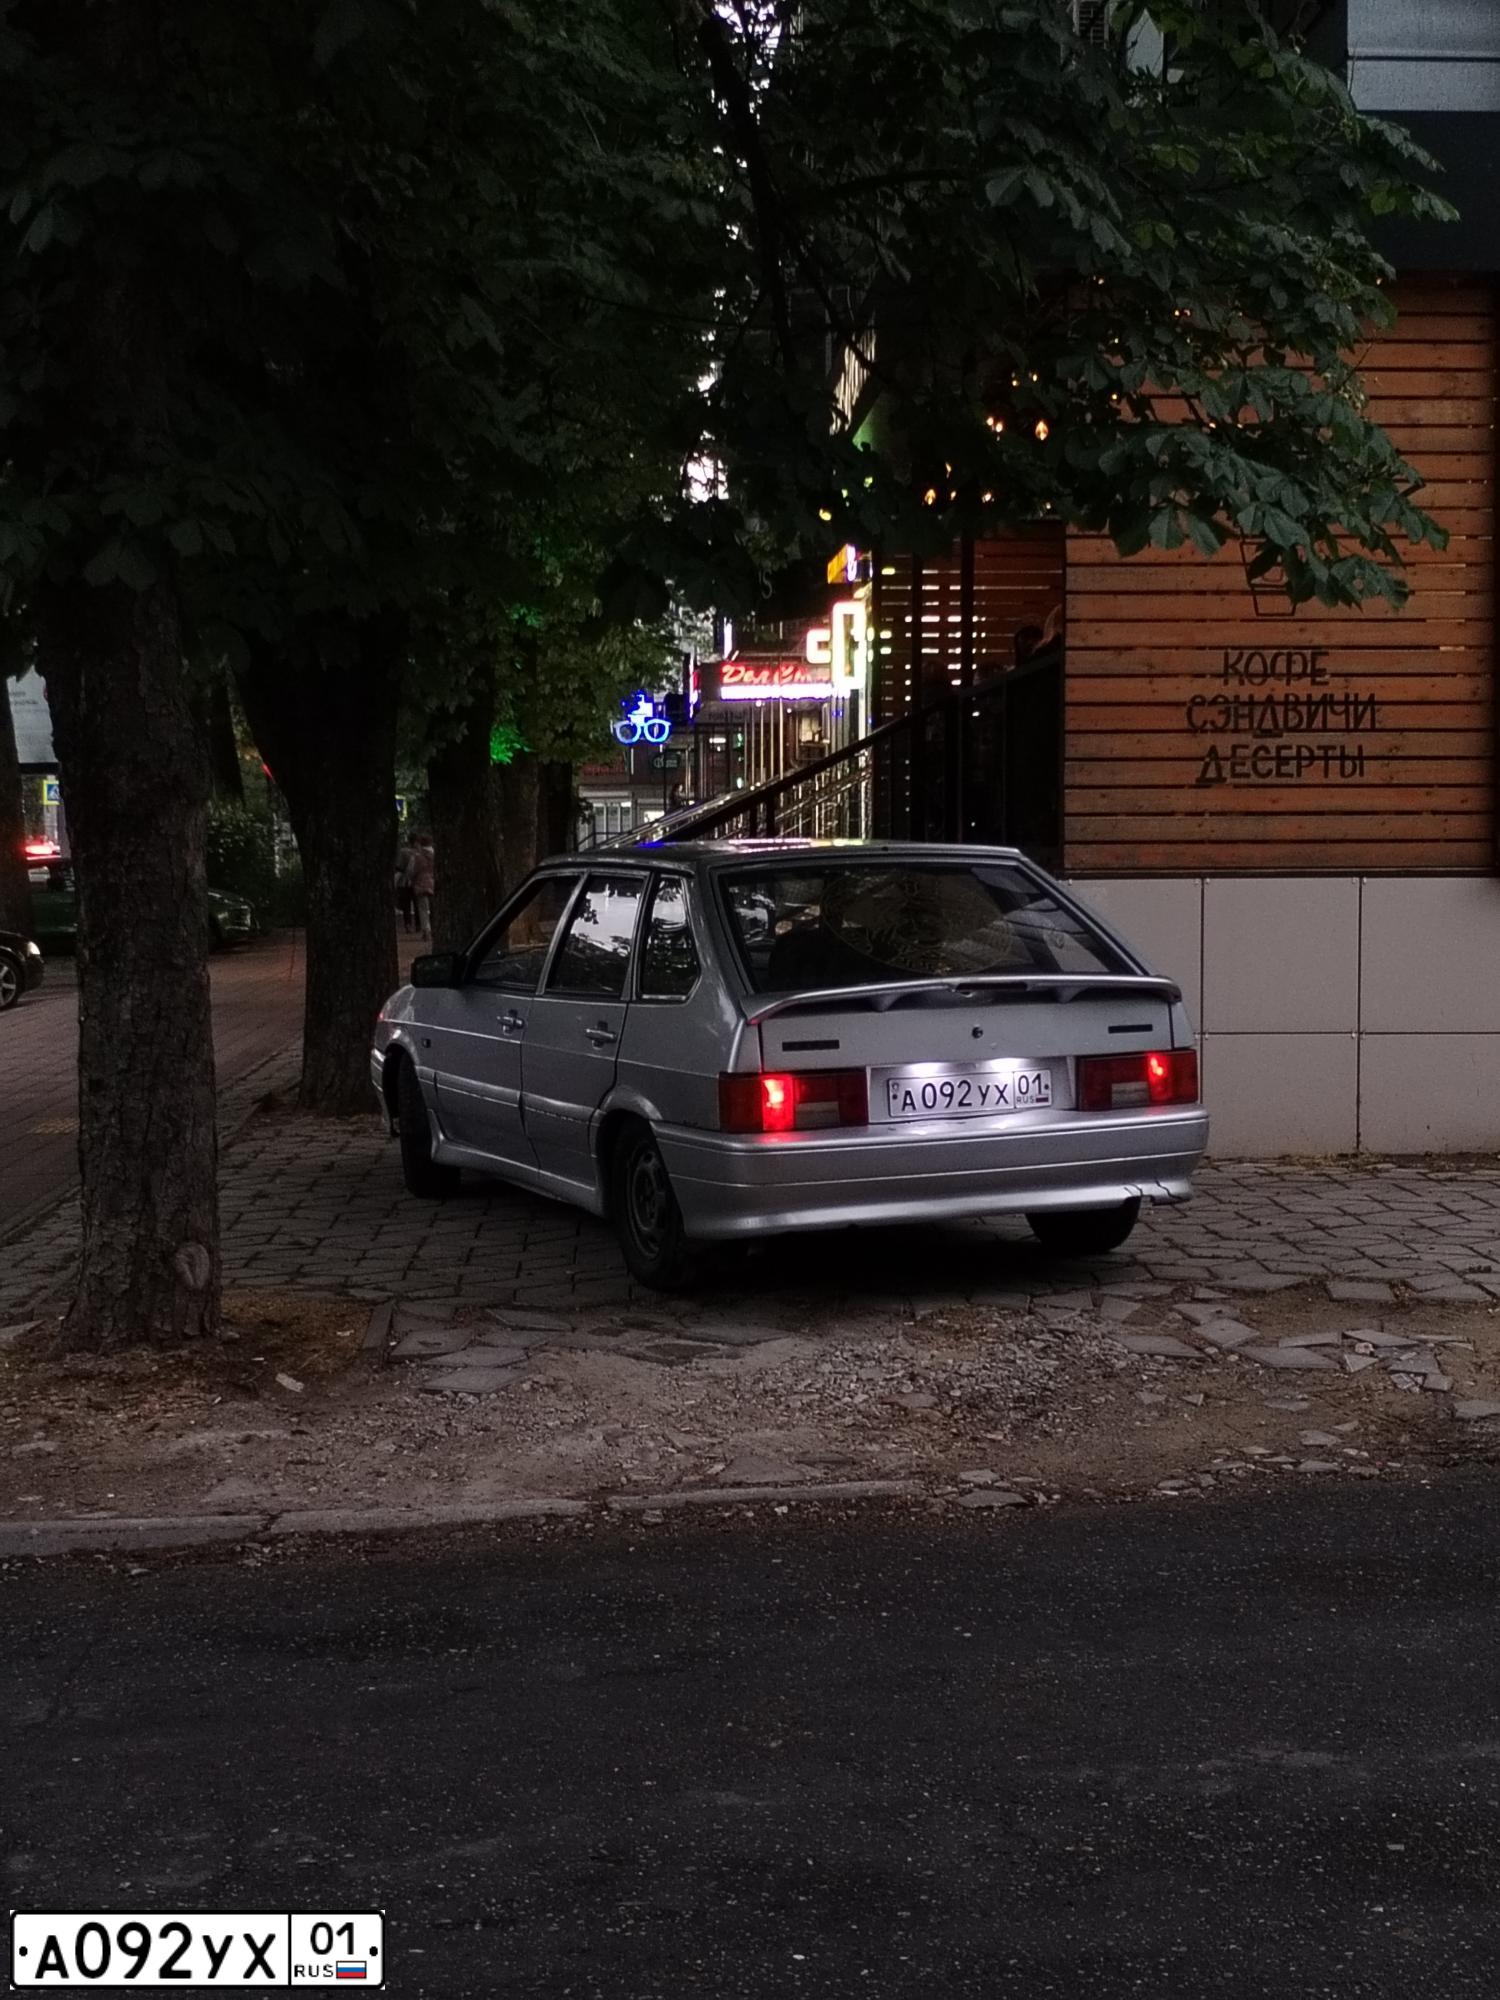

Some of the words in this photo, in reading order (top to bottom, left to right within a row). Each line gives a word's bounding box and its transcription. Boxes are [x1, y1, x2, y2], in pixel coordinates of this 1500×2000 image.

[1223, 651, 1330, 686] КОФЕ
[1186, 692, 1377, 739] СЭНДВИЧИ
[1195, 744, 1366, 785] ДЕСЕРТЫ
[1015, 1095, 1036, 1105] RUS
[1017, 1073, 1043, 1096] 01
